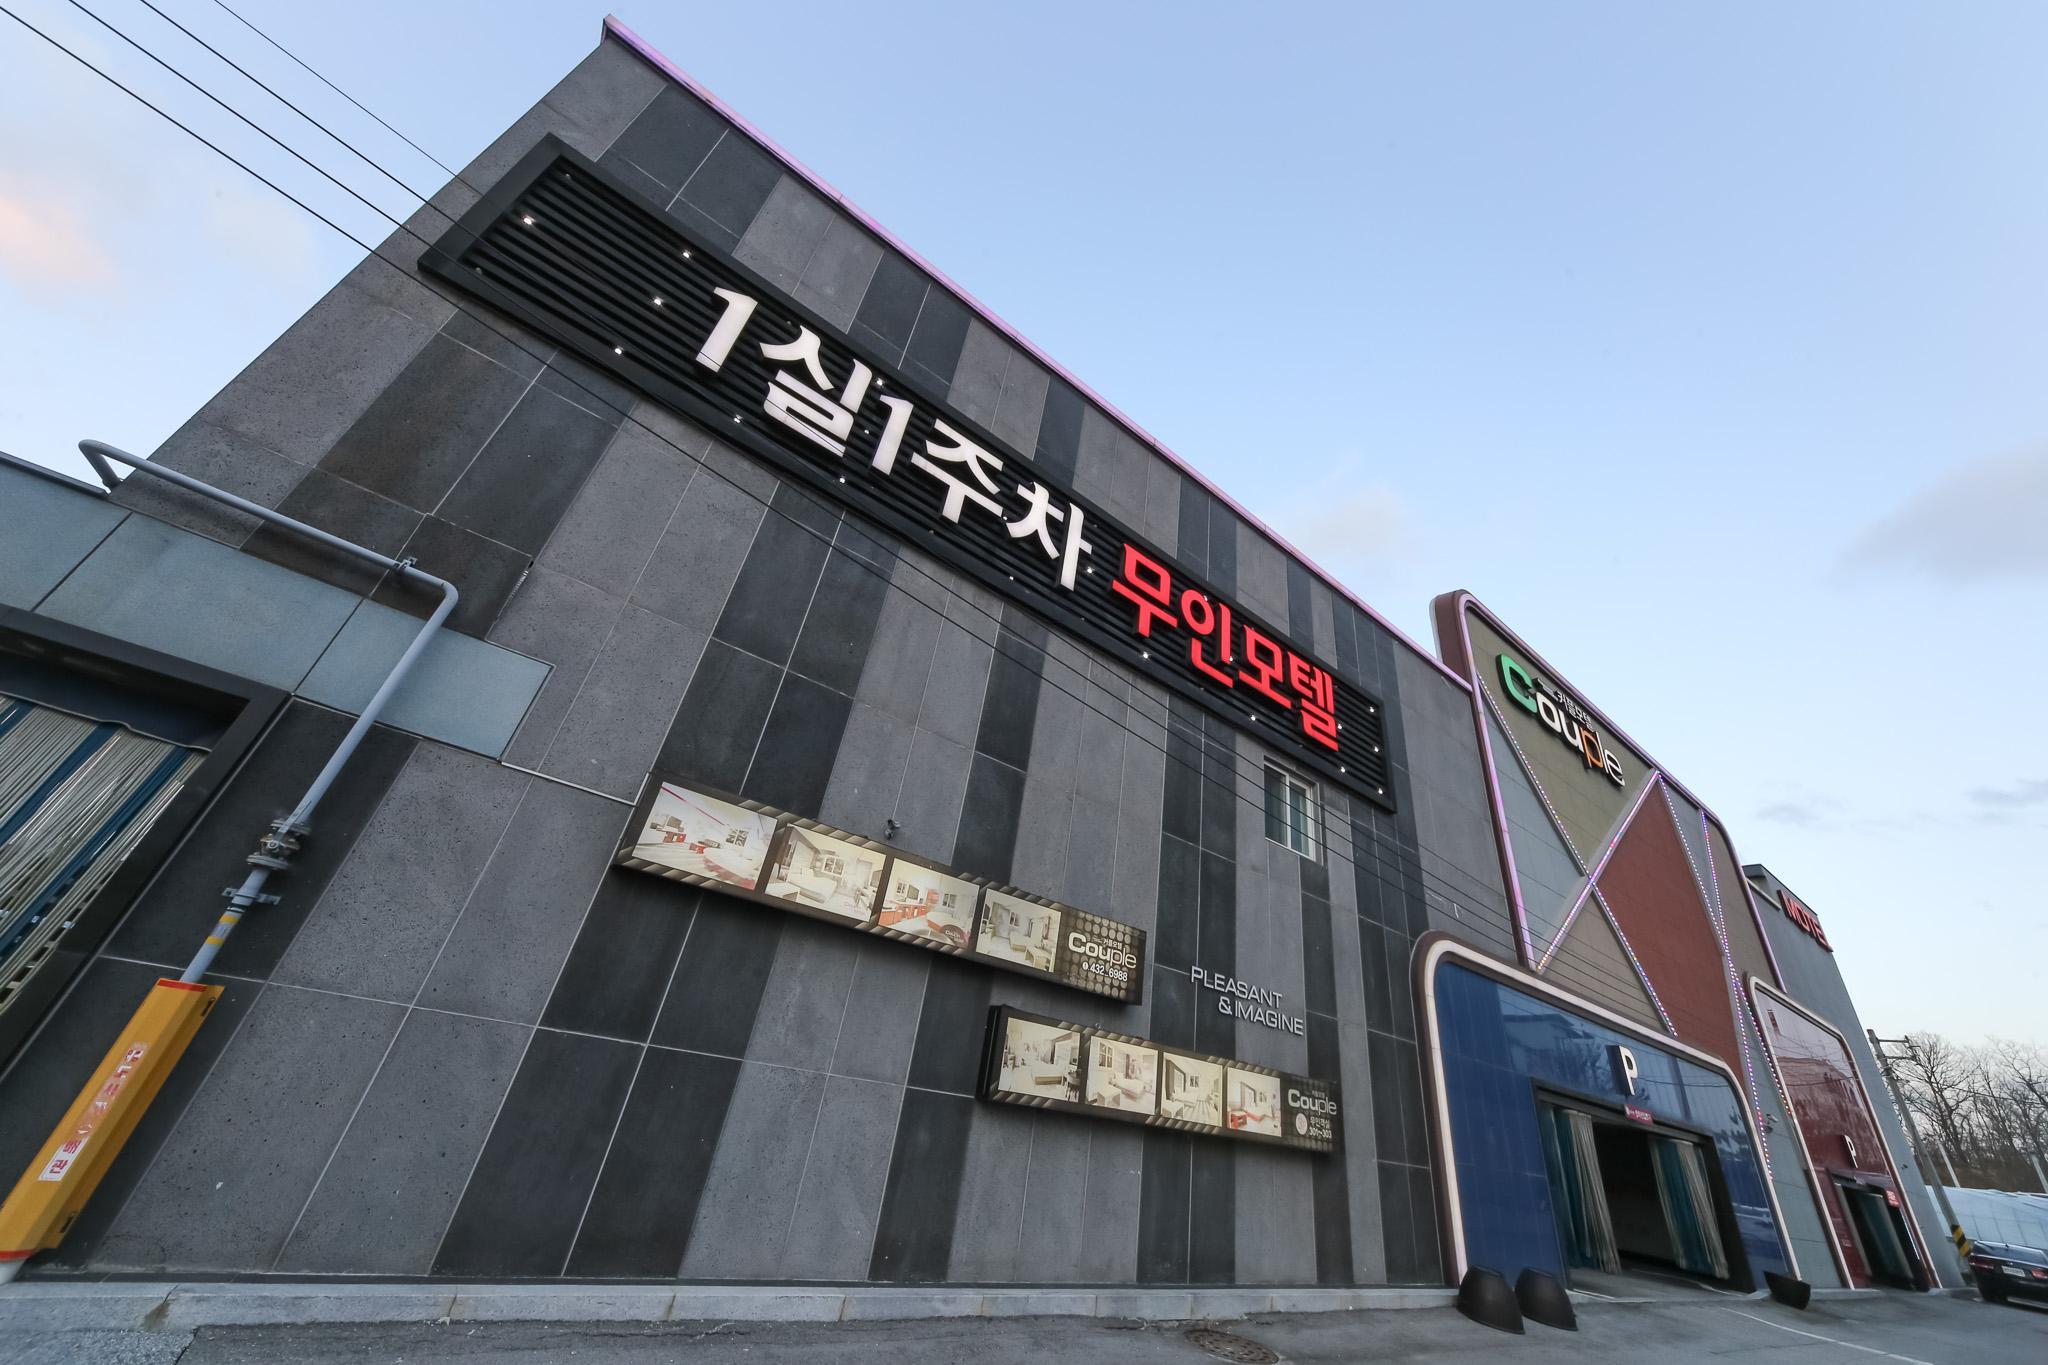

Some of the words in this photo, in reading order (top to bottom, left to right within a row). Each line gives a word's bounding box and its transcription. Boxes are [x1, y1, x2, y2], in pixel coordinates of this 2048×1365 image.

[1111, 543, 1340, 752] 무인모텔
[1497, 653, 1625, 786] Couple
[1068, 931, 1137, 969] Couple
[1190, 965, 1283, 1010] PLEASANT
[1619, 1045, 1638, 1096] P
[1288, 1088, 1337, 1116] Couple
[1844, 1134, 1859, 1169] P
